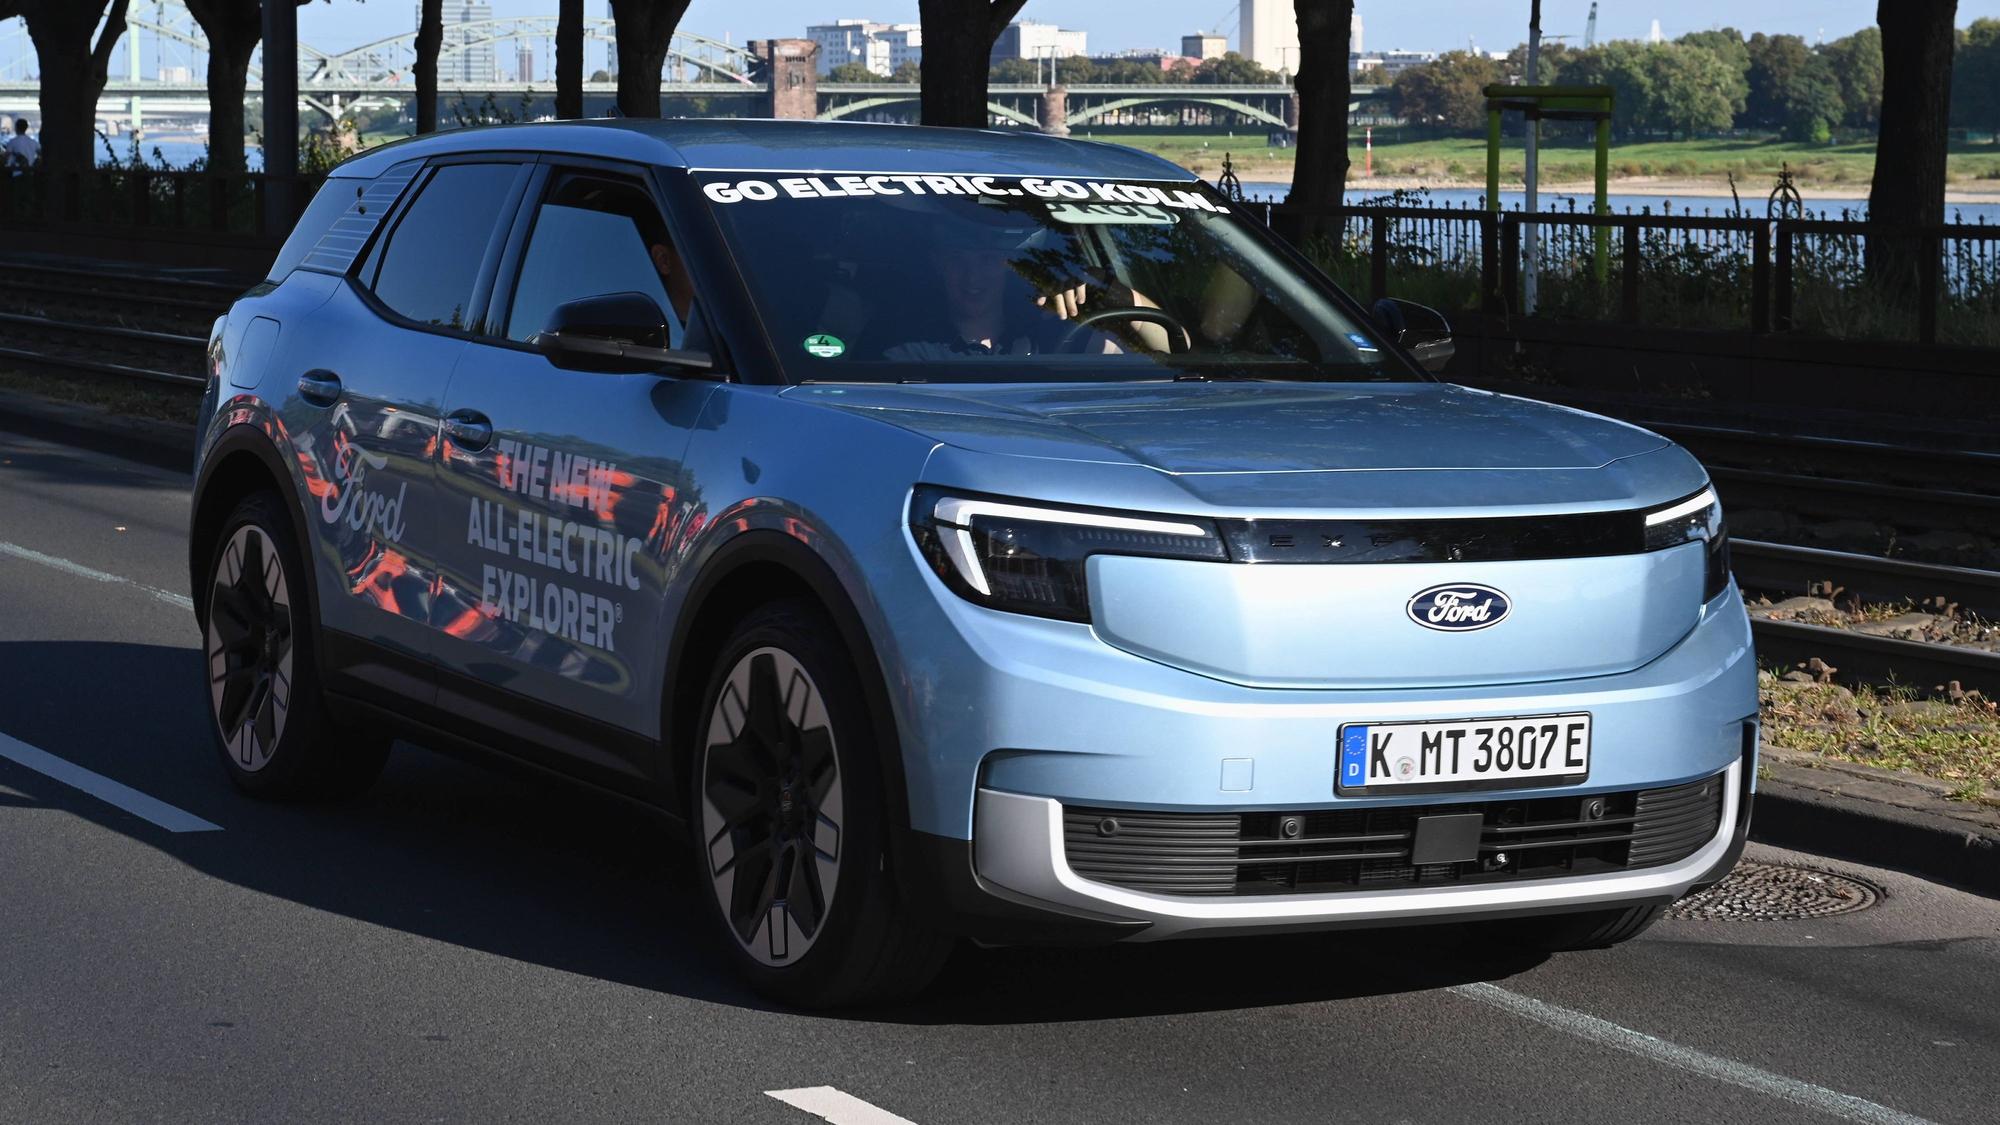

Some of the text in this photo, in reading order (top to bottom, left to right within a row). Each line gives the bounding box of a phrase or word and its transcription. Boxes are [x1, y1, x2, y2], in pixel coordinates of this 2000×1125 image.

[702, 180, 778, 203] GO
[777, 176, 1024, 199] ELECTRIC.
[1020, 178, 1090, 200] GO
[321, 442, 408, 543] Ford
[498, 438, 616, 513] THE NEW
[467, 496, 643, 591] ALL-ELECTRIC
[1428, 591, 1493, 622] Ford
[1349, 763, 1360, 777] D
